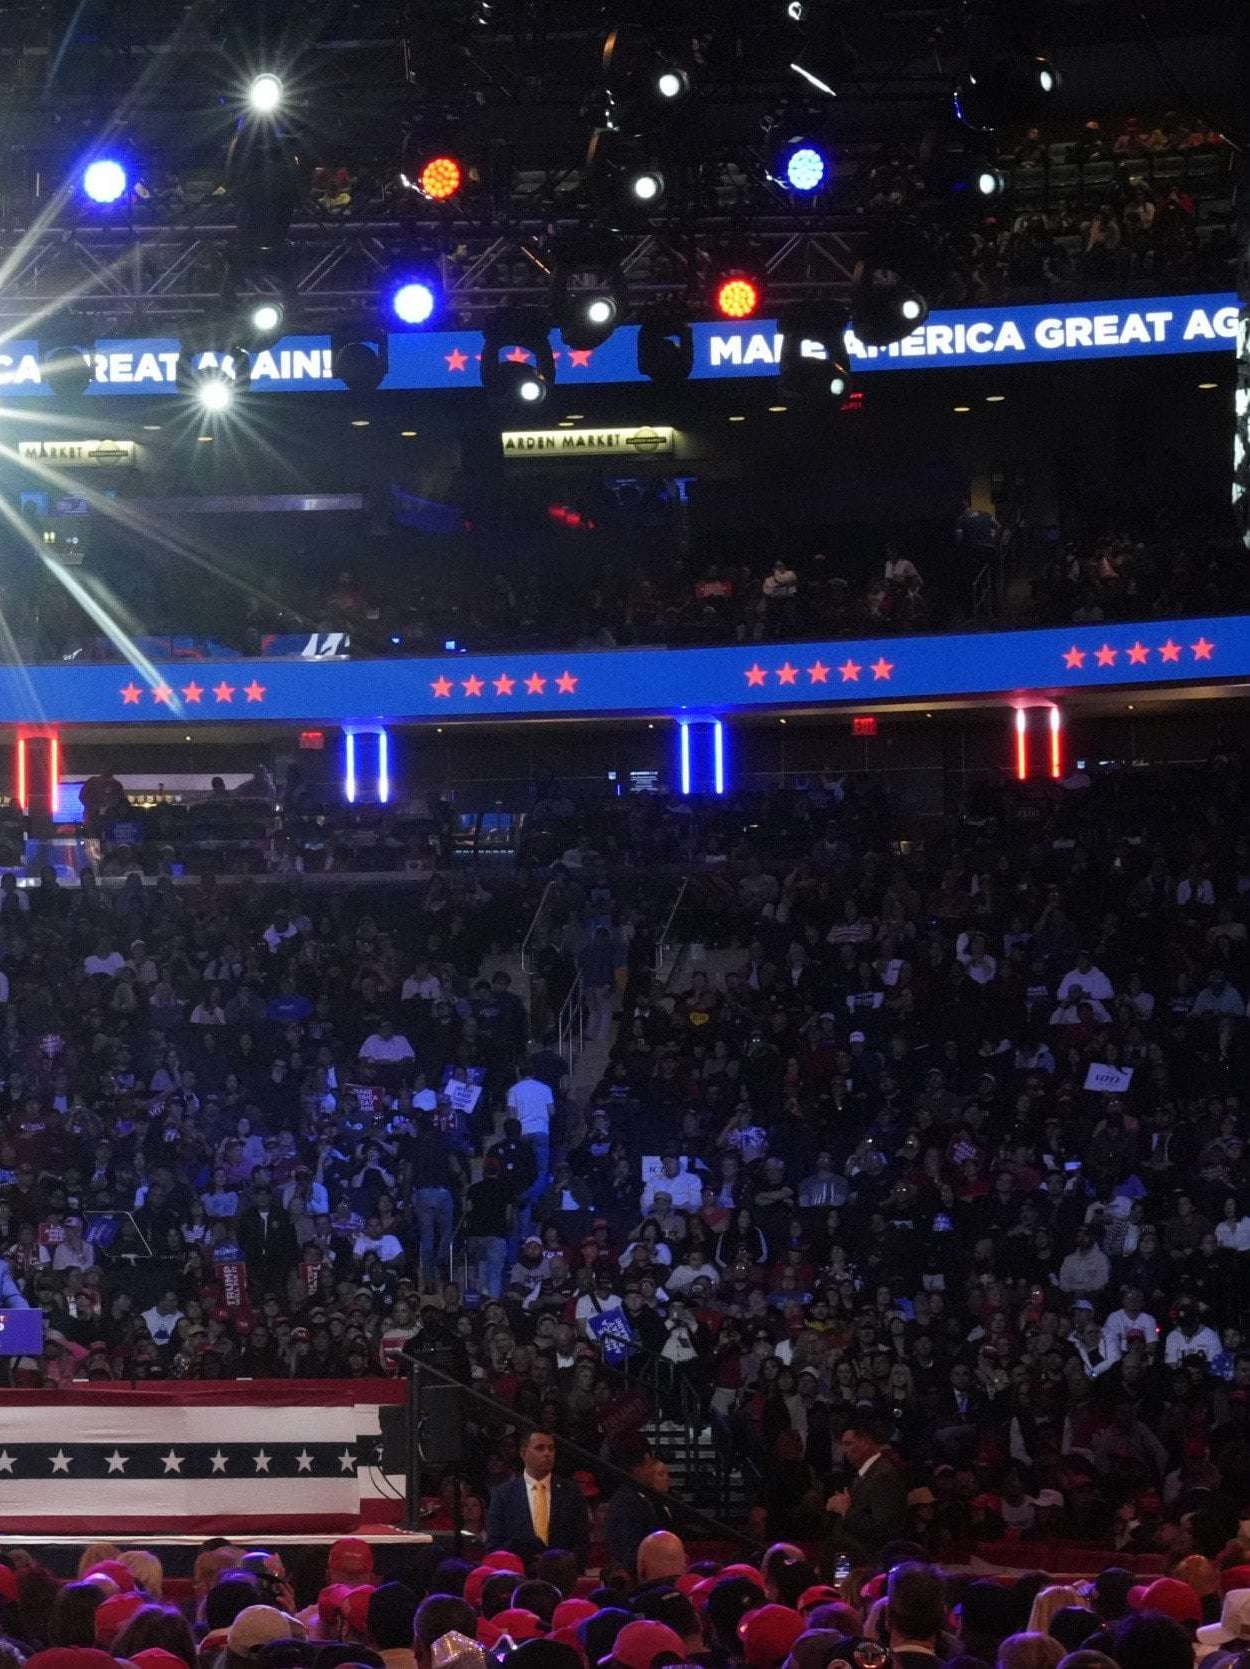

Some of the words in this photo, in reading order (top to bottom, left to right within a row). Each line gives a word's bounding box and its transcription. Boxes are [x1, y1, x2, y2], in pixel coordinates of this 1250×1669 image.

[844, 320, 1026, 359] AERICA
[1034, 311, 1173, 349] GREAT
[93, 352, 180, 383] REAT
[26, 446, 83, 459] MARKET
[506, 436, 555, 450] ARDEN
[562, 434, 621, 447] MARKET
